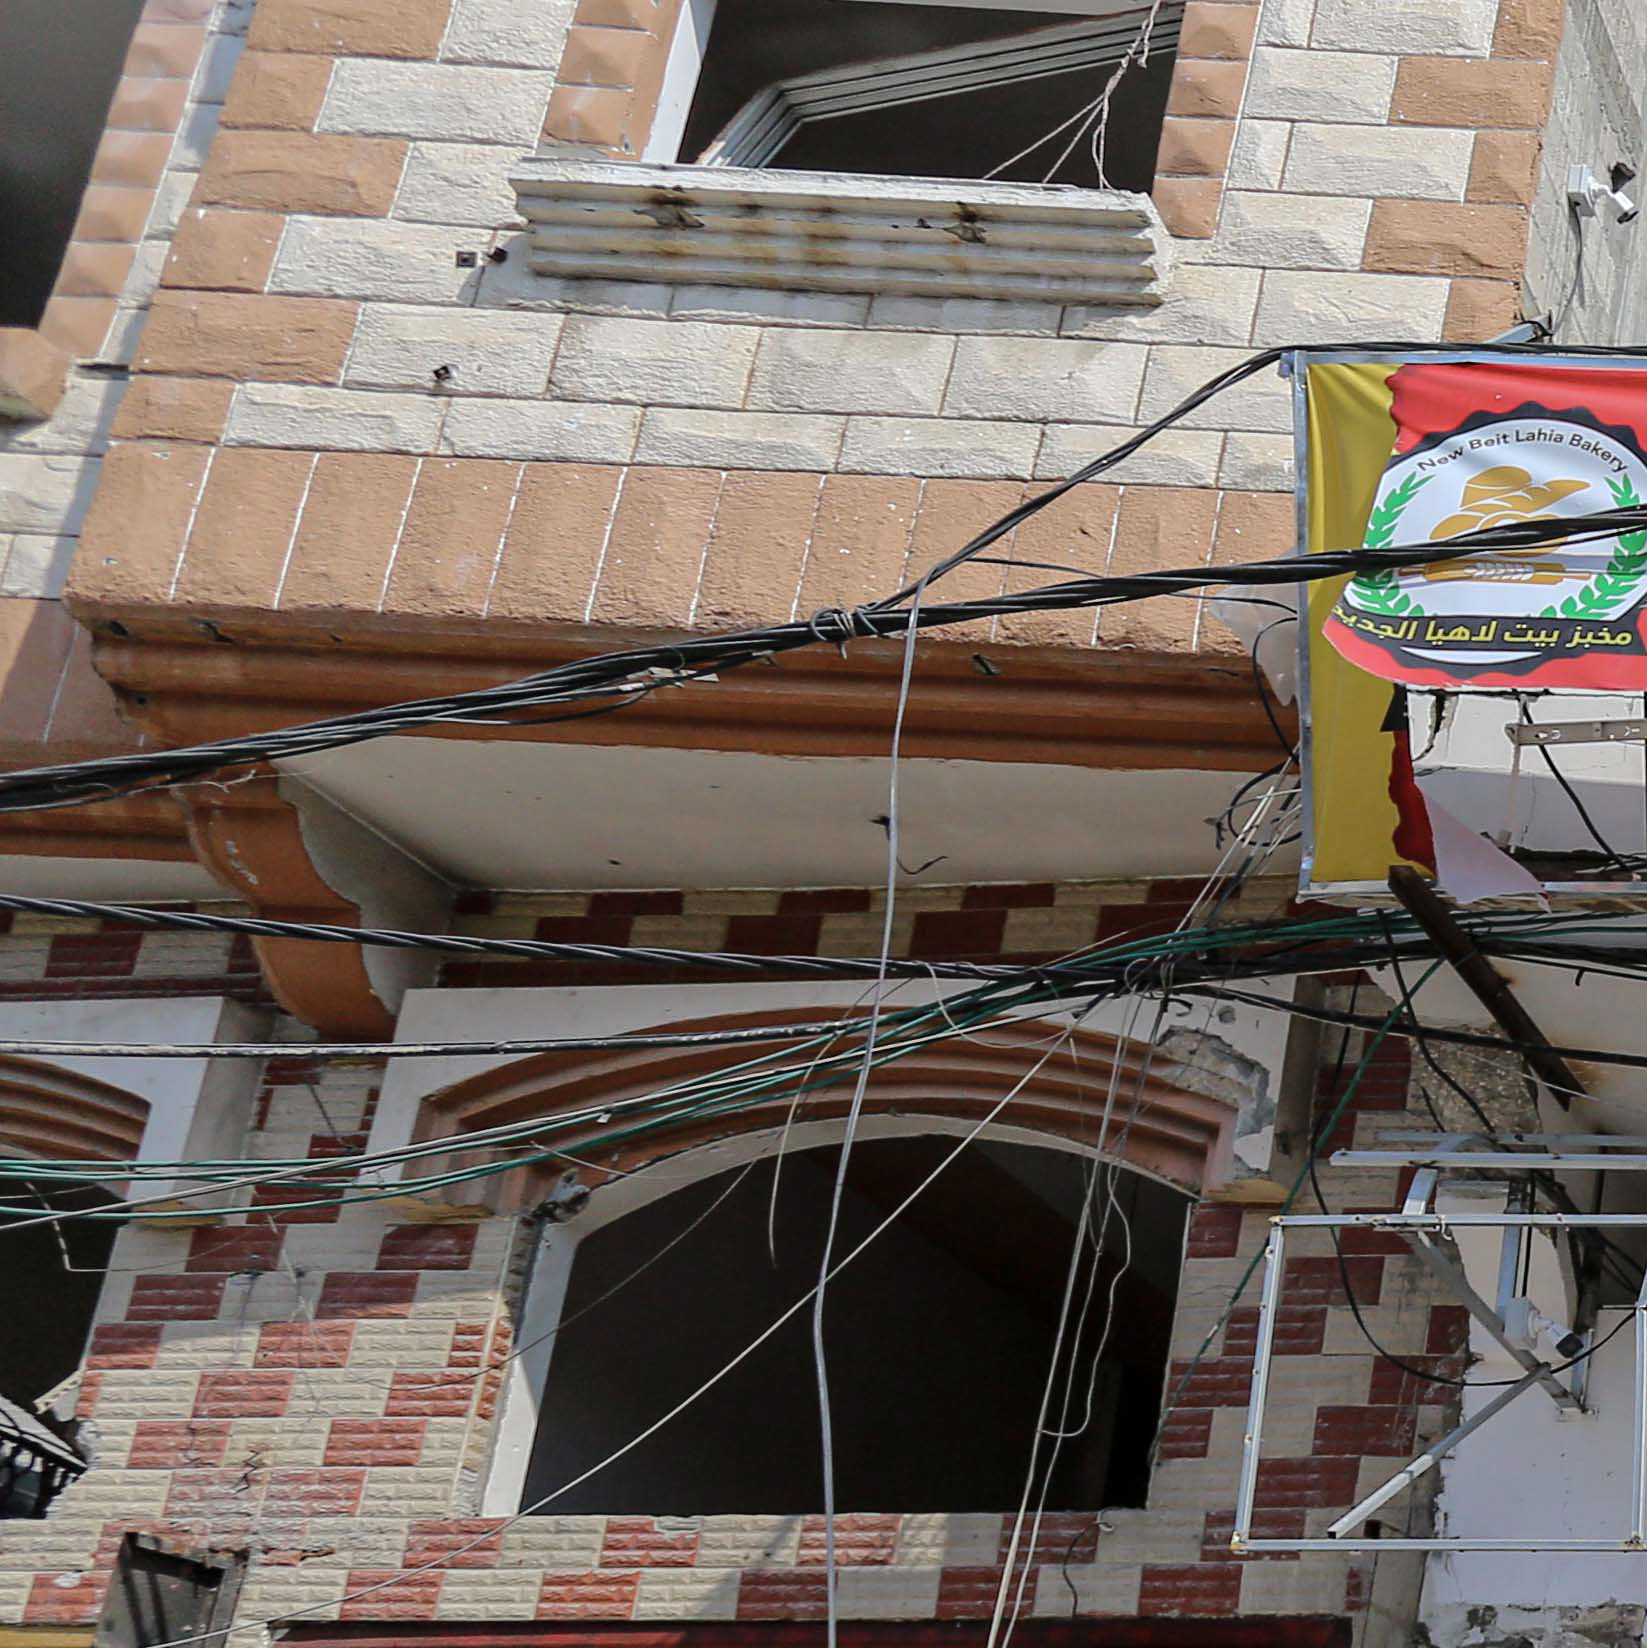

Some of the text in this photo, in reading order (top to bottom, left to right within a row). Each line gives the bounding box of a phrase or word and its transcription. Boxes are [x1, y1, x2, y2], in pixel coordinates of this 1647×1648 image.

[1417, 428, 1629, 473] New Beit Lahia Bakery
[1424, 619, 1498, 645] لاهيا
[1503, 623, 1560, 647] بيت
[1565, 626, 1634, 648] مخبز
